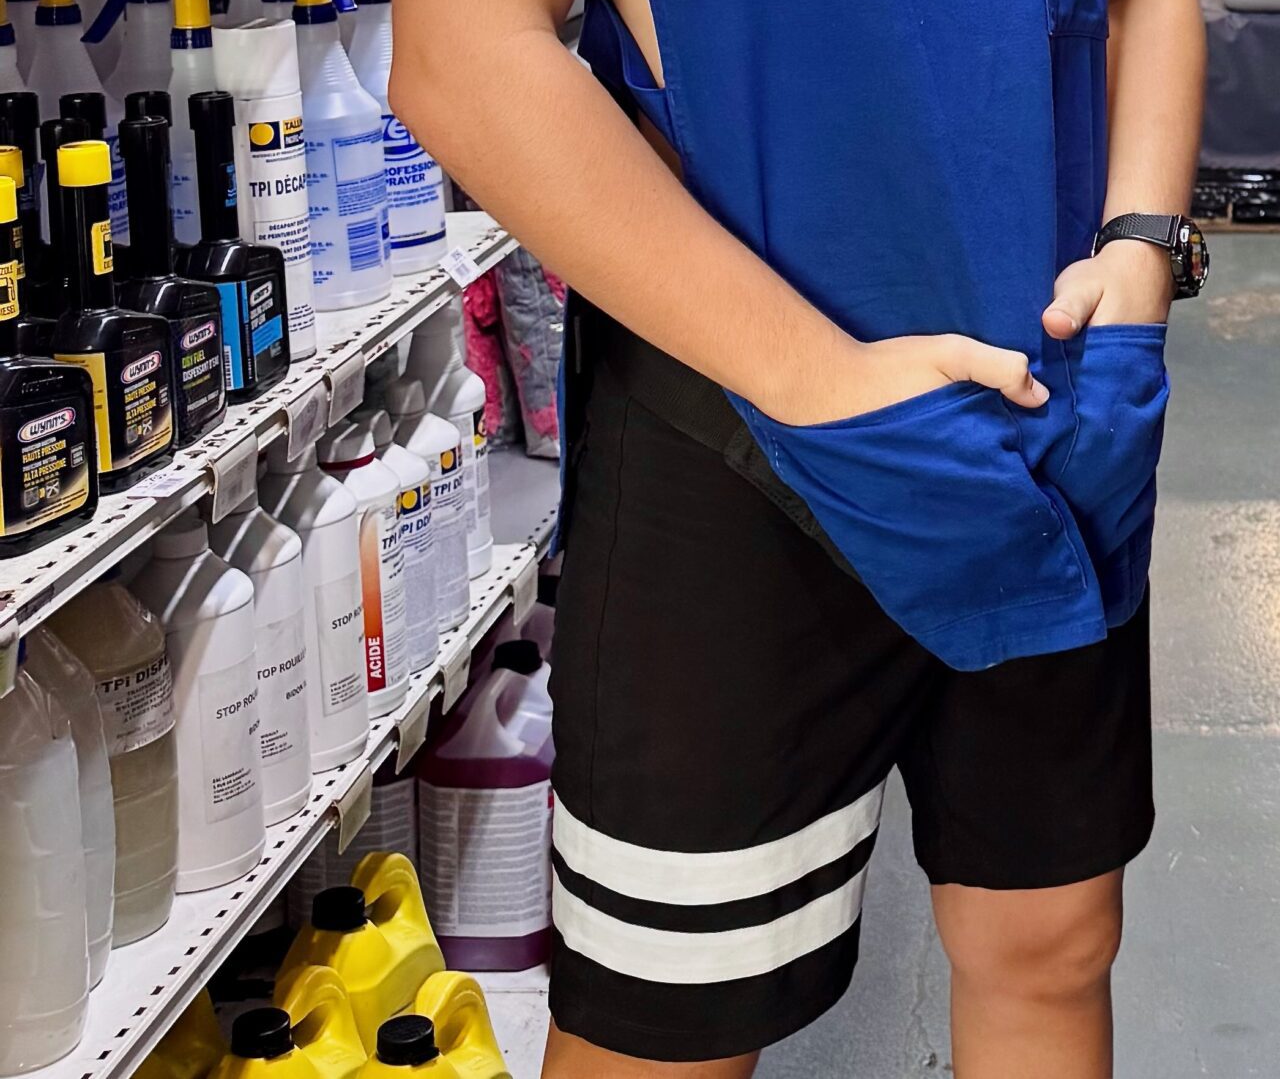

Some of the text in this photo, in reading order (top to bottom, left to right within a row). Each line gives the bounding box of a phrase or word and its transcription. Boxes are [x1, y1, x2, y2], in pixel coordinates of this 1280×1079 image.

[250, 181, 272, 198] TPI
[24, 469, 38, 482] ALTA
[434, 482, 451, 497] TPI
[382, 532, 397, 550] TPI
[331, 613, 353, 630] STOP
[368, 636, 382, 679] ACIDE
[216, 700, 242, 720] STOP
